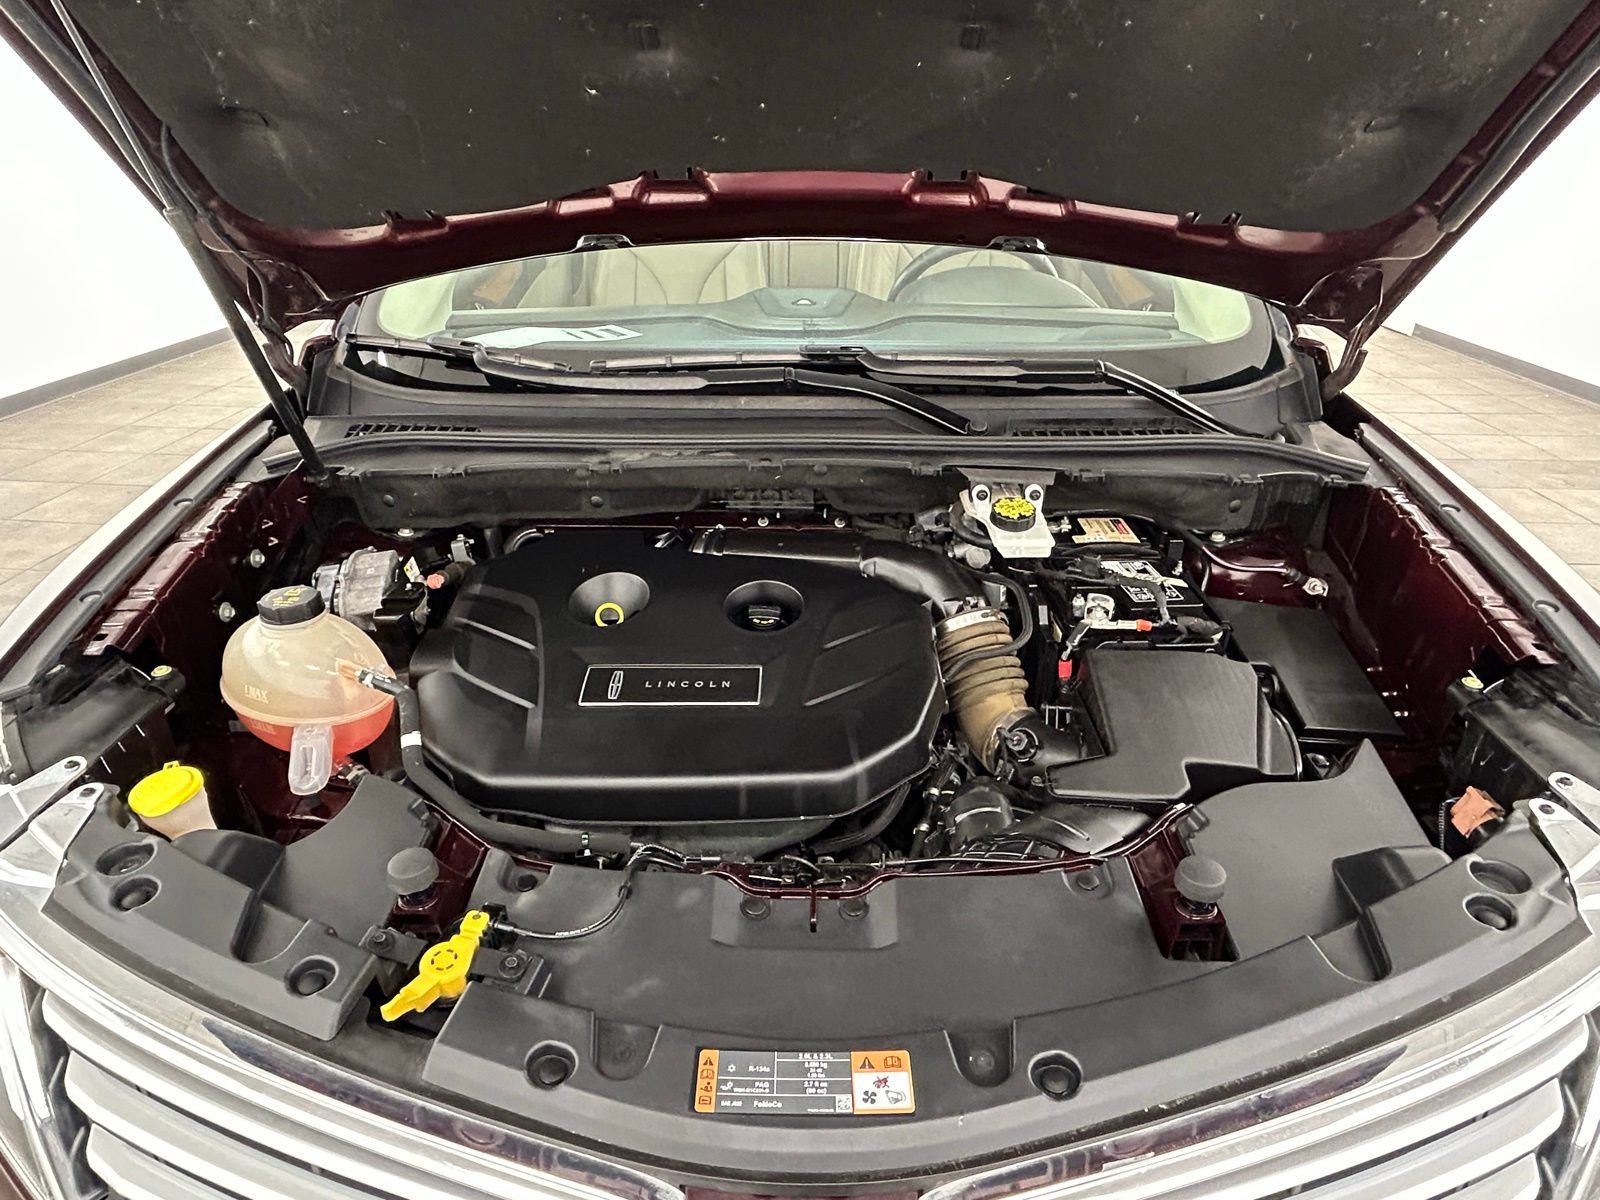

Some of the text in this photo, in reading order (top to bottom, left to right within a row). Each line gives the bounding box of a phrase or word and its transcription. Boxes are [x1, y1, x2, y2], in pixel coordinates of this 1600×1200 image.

[644, 680, 731, 688] LINCOLN
[748, 1065, 770, 1073] R-134a
[753, 1100, 783, 1108] FoMoCo
